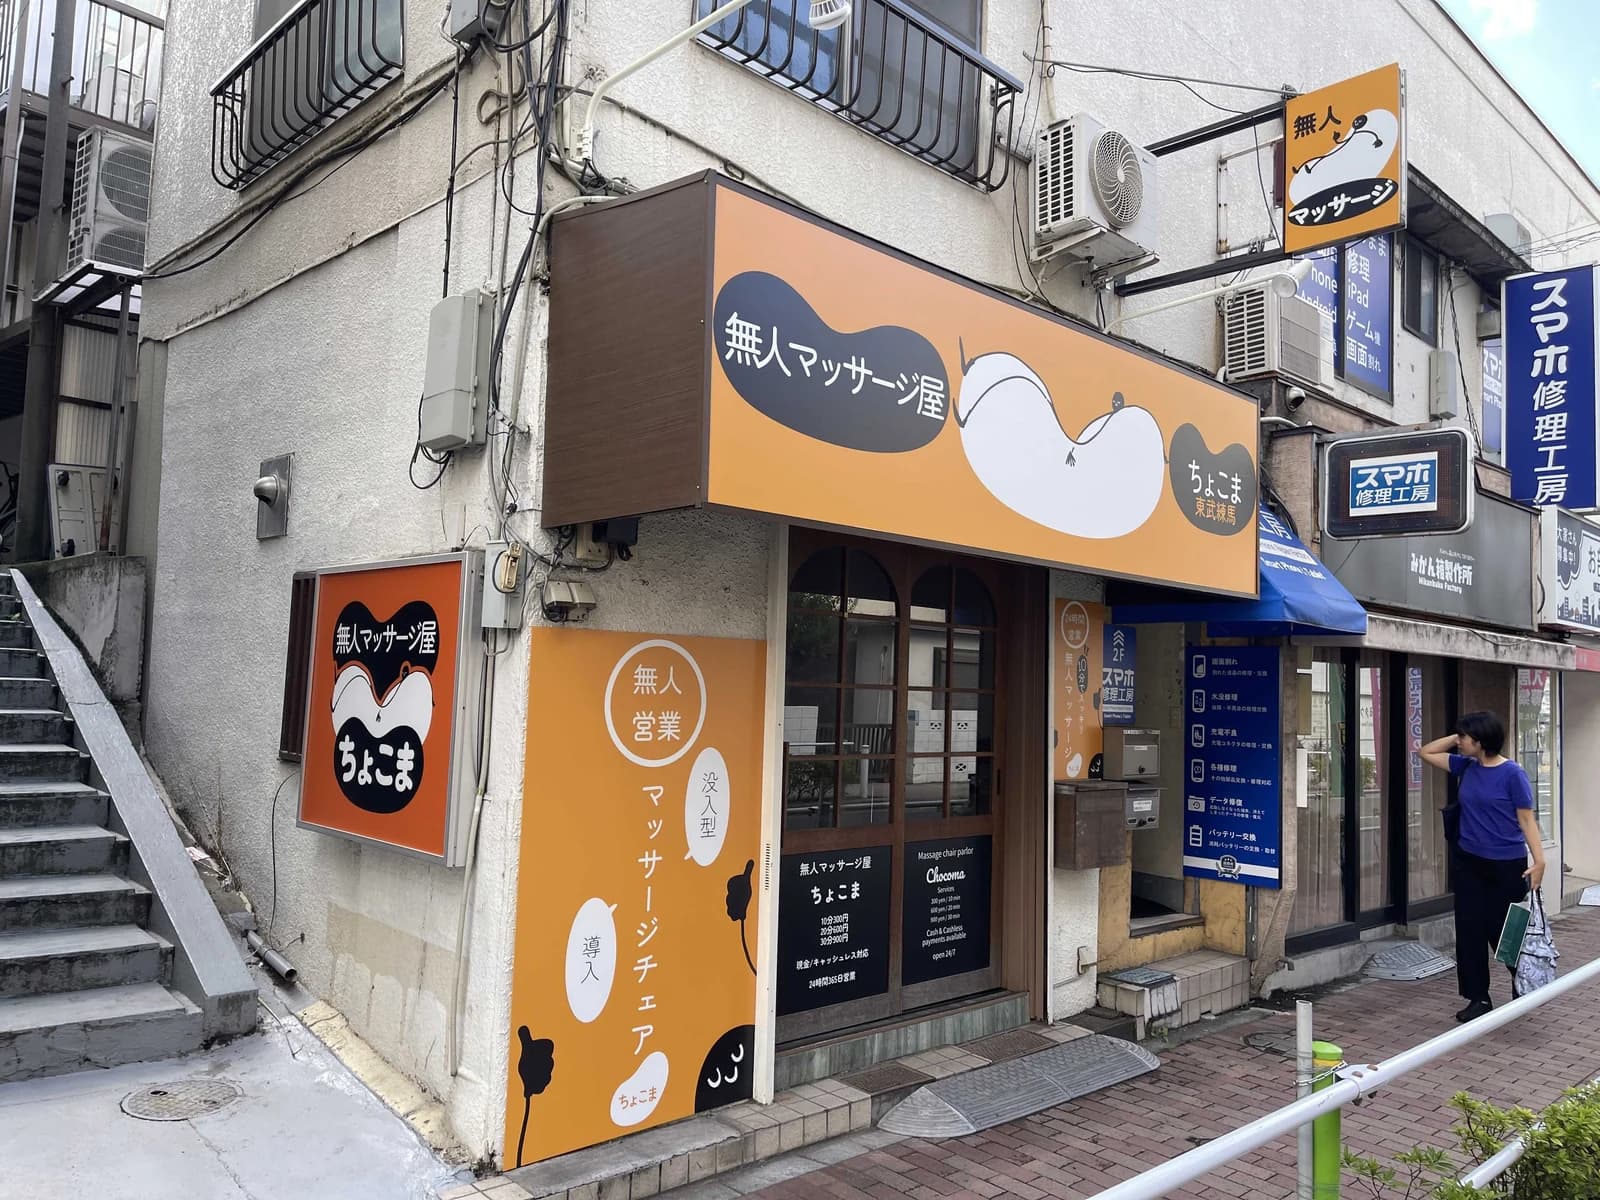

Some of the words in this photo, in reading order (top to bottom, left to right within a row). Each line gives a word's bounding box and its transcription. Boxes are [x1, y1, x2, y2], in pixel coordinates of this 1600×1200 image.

[1294, 105, 1341, 139] 無人
[1288, 179, 1393, 225] マッサージ
[1347, 247, 1370, 284] 修理
[1347, 278, 1369, 309] iPad
[724, 311, 945, 421] 無人マッサージ屋
[1530, 278, 1569, 504] スマホ修理工房
[1187, 459, 1242, 505] ちょこま
[1355, 462, 1431, 489] スマホ
[1194, 496, 1237, 526] 東武練馬
[1355, 484, 1431, 507] 修理工房
[335, 620, 437, 654] 無人マッサージ屋
[1112, 648, 1125, 662] 2F
[633, 663, 682, 695] 無人
[1103, 667, 1135, 686] スマホ
[1103, 687, 1135, 702] 修理工房
[633, 710, 682, 742] 営業
[338, 734, 415, 792] ちょこま
[700, 771, 718, 838] 没入型
[1208, 828, 1257, 842] バッテリー交換
[800, 855, 872, 876] 無人マッサージ屋
[918, 850, 942, 861] Massage
[942, 848, 957, 857] chair
[957, 847, 974, 858] parlor
[926, 866, 966, 883] Chocoma
[811, 881, 860, 905] ちょこま
[632, 785, 664, 1056] マッサージチェア
[581, 936, 602, 984] 導入
[932, 951, 945, 961] open
[618, 1087, 657, 1110] ちょこま
